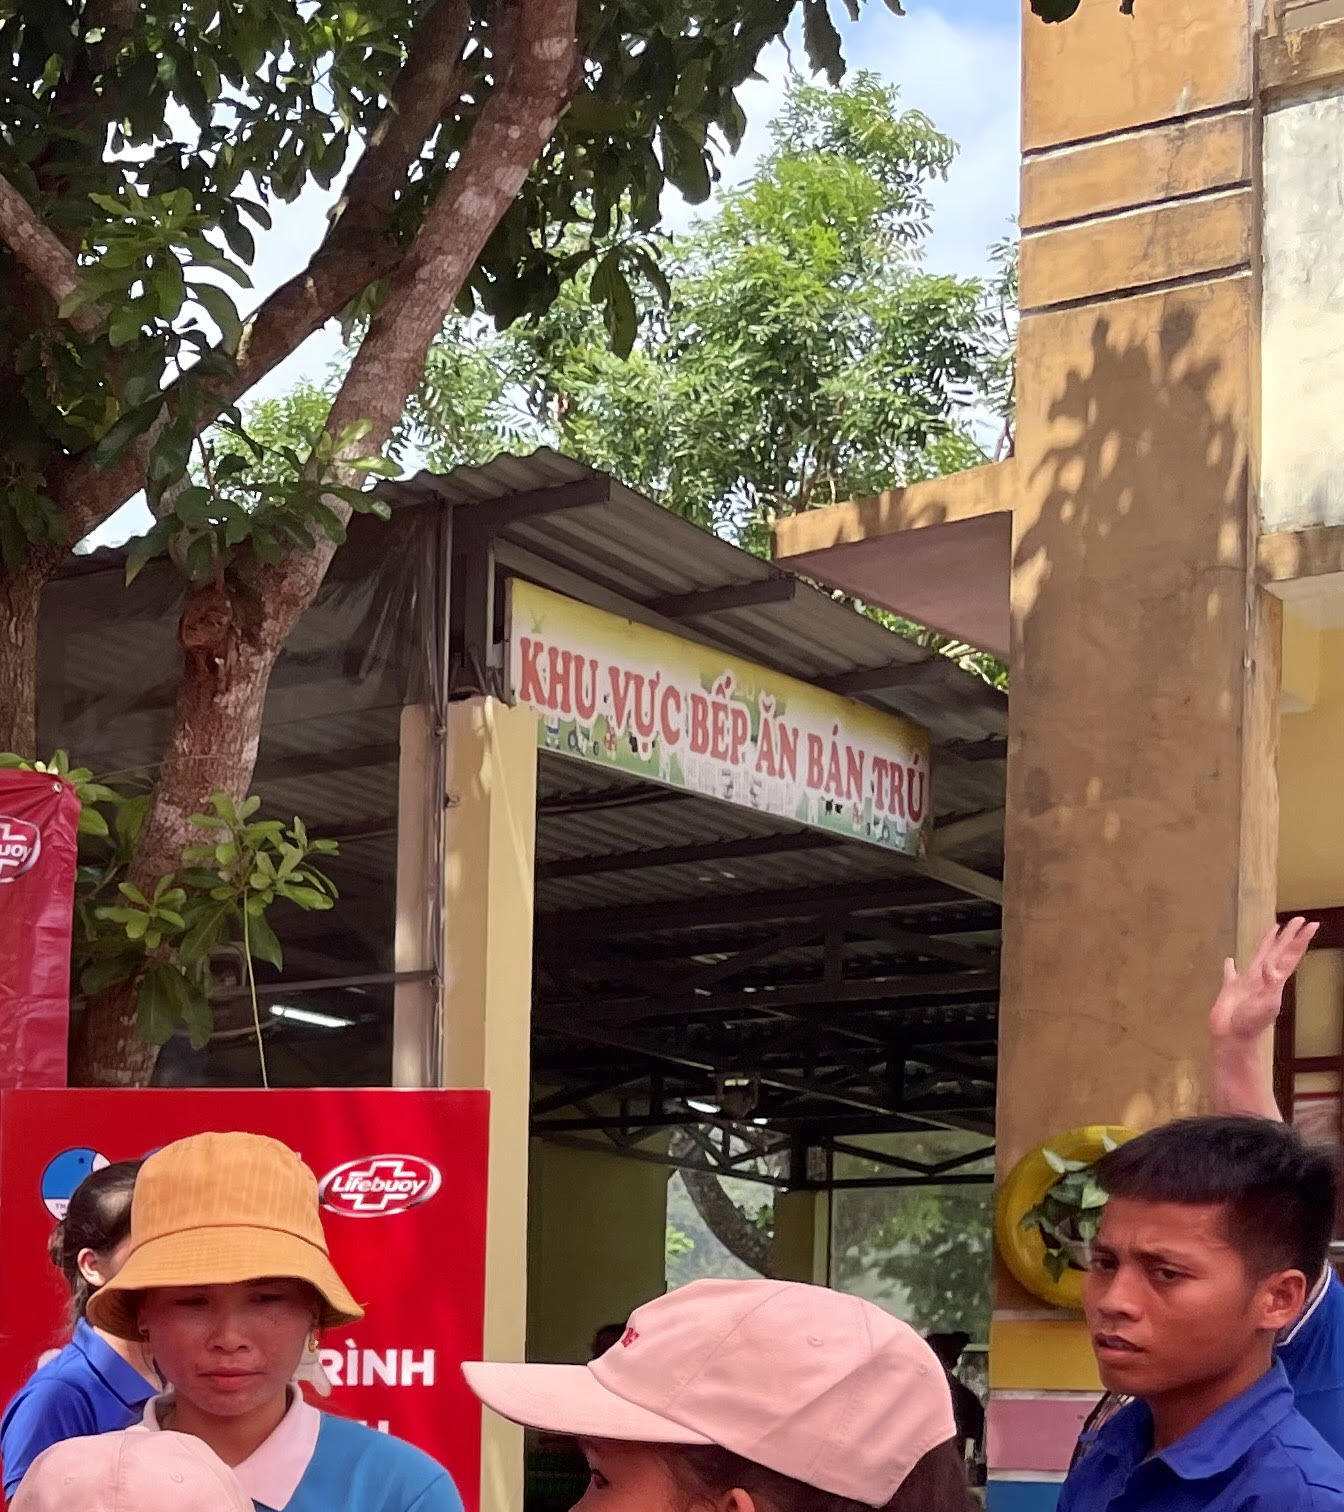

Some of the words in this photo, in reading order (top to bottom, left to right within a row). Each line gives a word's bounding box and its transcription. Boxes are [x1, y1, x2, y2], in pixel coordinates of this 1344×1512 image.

[519, 636, 599, 721] KHU
[608, 664, 682, 754] VỰC
[689, 674, 750, 766] BẾP
[754, 699, 800, 783] ĂN
[806, 722, 865, 801] BÁN
[871, 752, 926, 824] TRÚ
[330, 1174, 431, 1198] Lifebuoy
[318, 1337, 435, 1387] RÌNH
